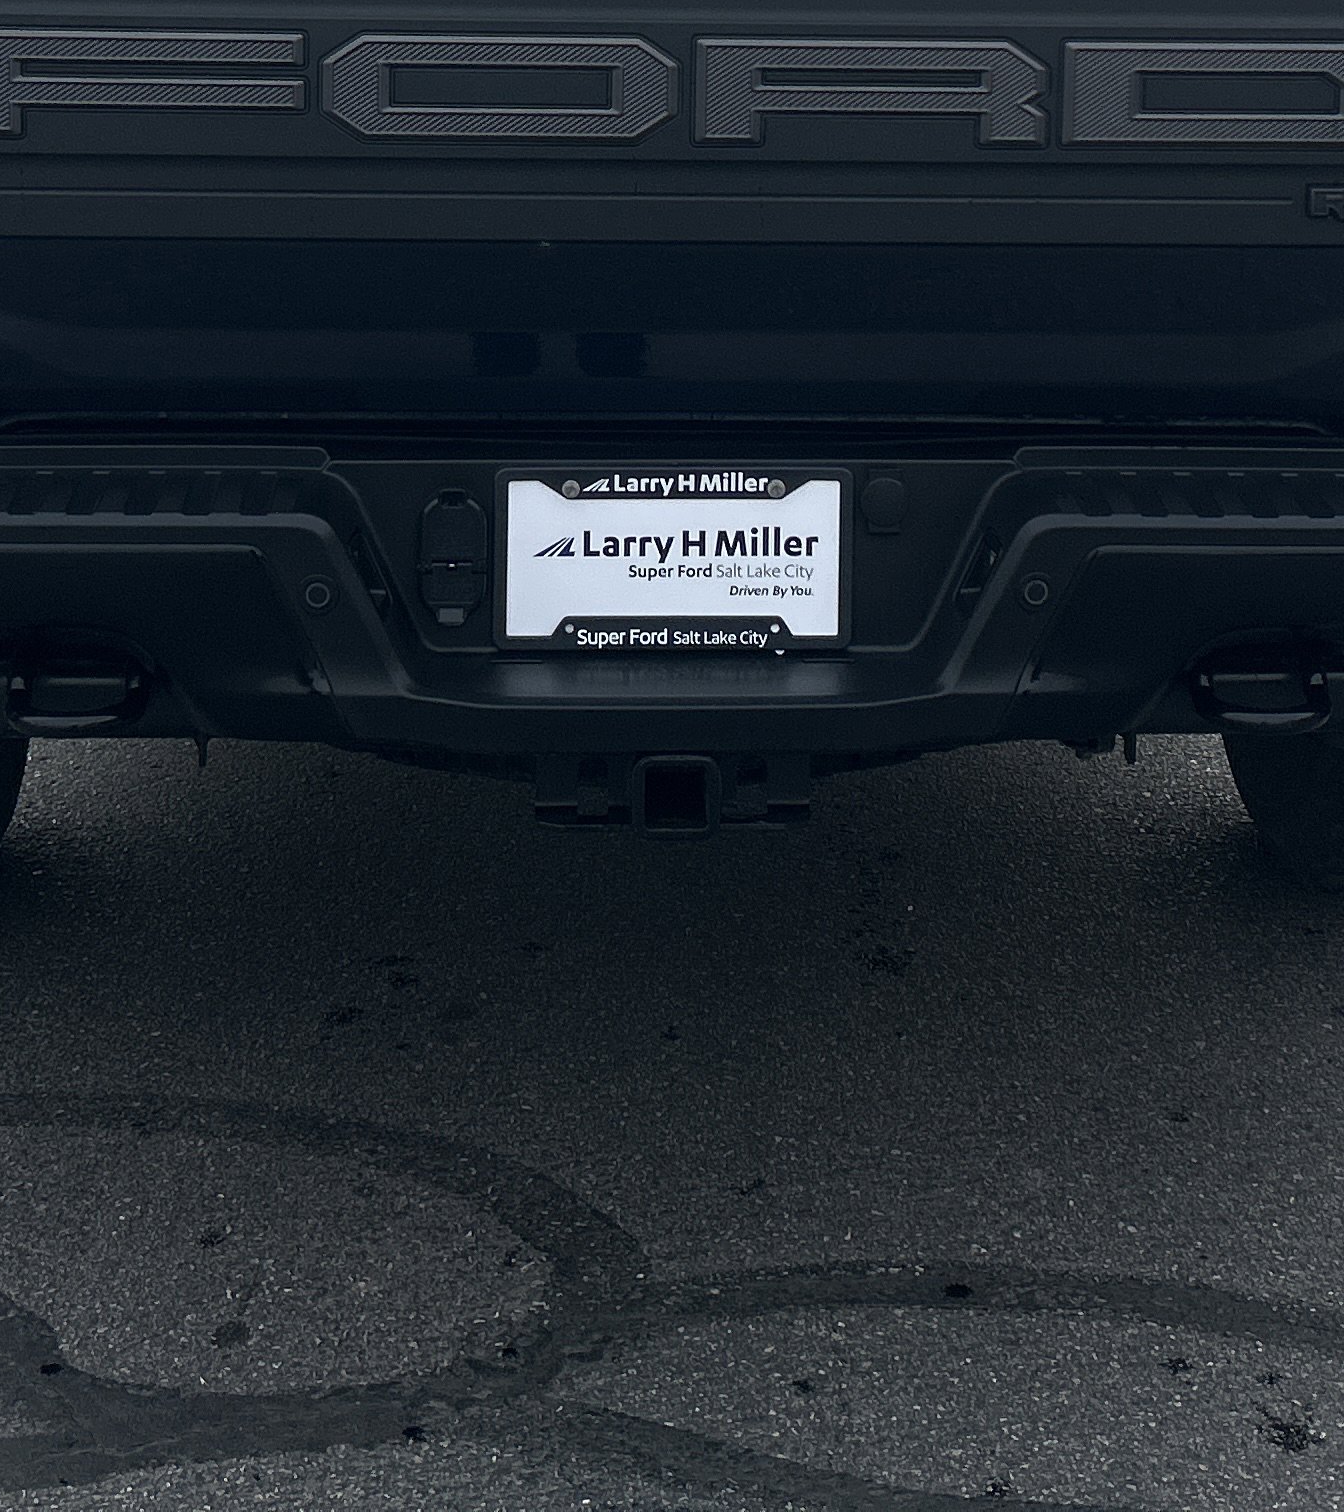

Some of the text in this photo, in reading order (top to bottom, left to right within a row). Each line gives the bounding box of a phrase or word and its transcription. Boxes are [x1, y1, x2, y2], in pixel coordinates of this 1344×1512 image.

[613, 472, 769, 497] Larry H Miller
[583, 526, 818, 564] Larry H Miller
[628, 562, 814, 582] Super Ford Salt Lake City
[729, 584, 769, 596] Driven
[772, 585, 788, 599] By
[576, 627, 768, 649] Super Ford Salt Lake City
